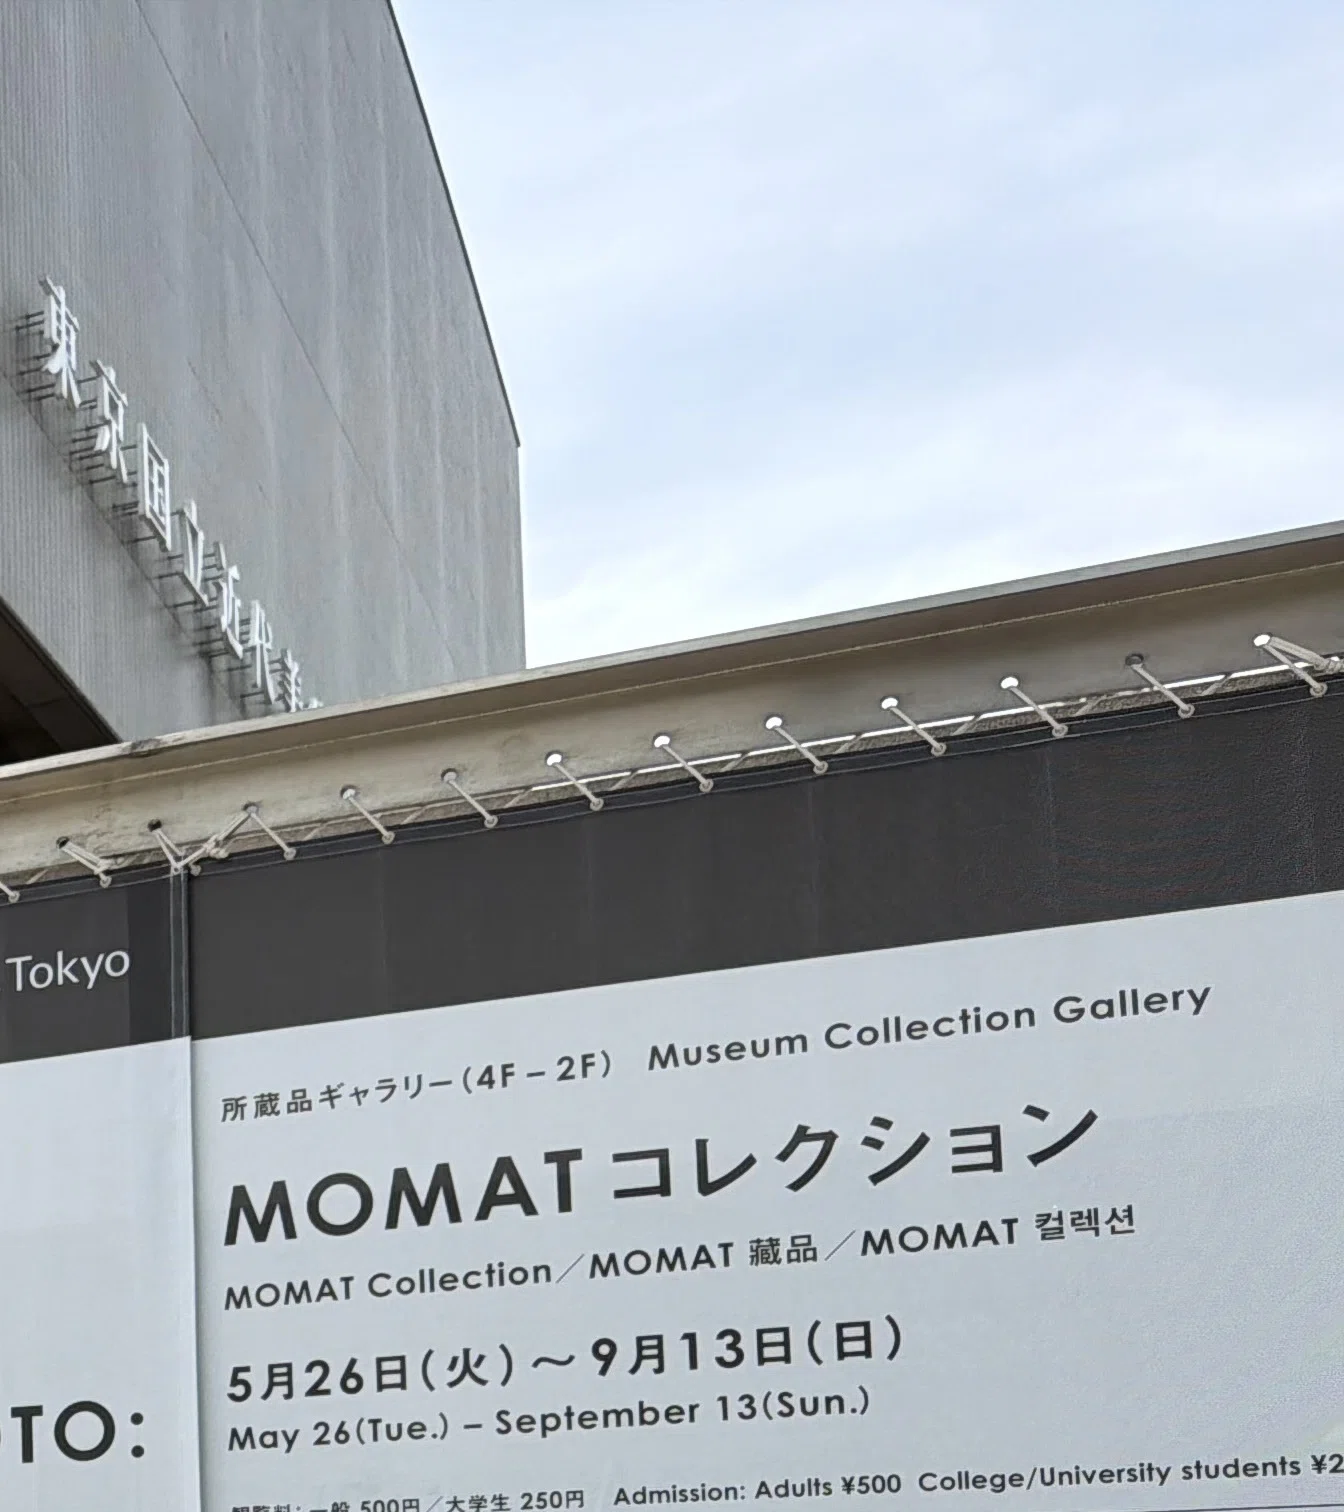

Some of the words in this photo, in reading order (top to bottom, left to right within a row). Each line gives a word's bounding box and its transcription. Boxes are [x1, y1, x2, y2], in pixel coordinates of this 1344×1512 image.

[38, 274, 324, 712] 東京国立近代美
[4, 950, 130, 992] Tokyo
[648, 1033, 808, 1071] Museum
[824, 1006, 1036, 1050] Collection
[1053, 986, 1211, 1024] Gallery
[224, 1275, 355, 1311] MOMAT
[1034, 1204, 1135, 1241] 컬렉션
[227, 1426, 300, 1454] May
[495, 1400, 700, 1439] September
[520, 1489, 585, 1511] 250円
[613, 1482, 746, 1506] Admission:
[754, 1477, 833, 1500] Adults
[840, 1473, 902, 1495] ¥500
[918, 1462, 1172, 1494] College/University
[1181, 1455, 1302, 1481] students
